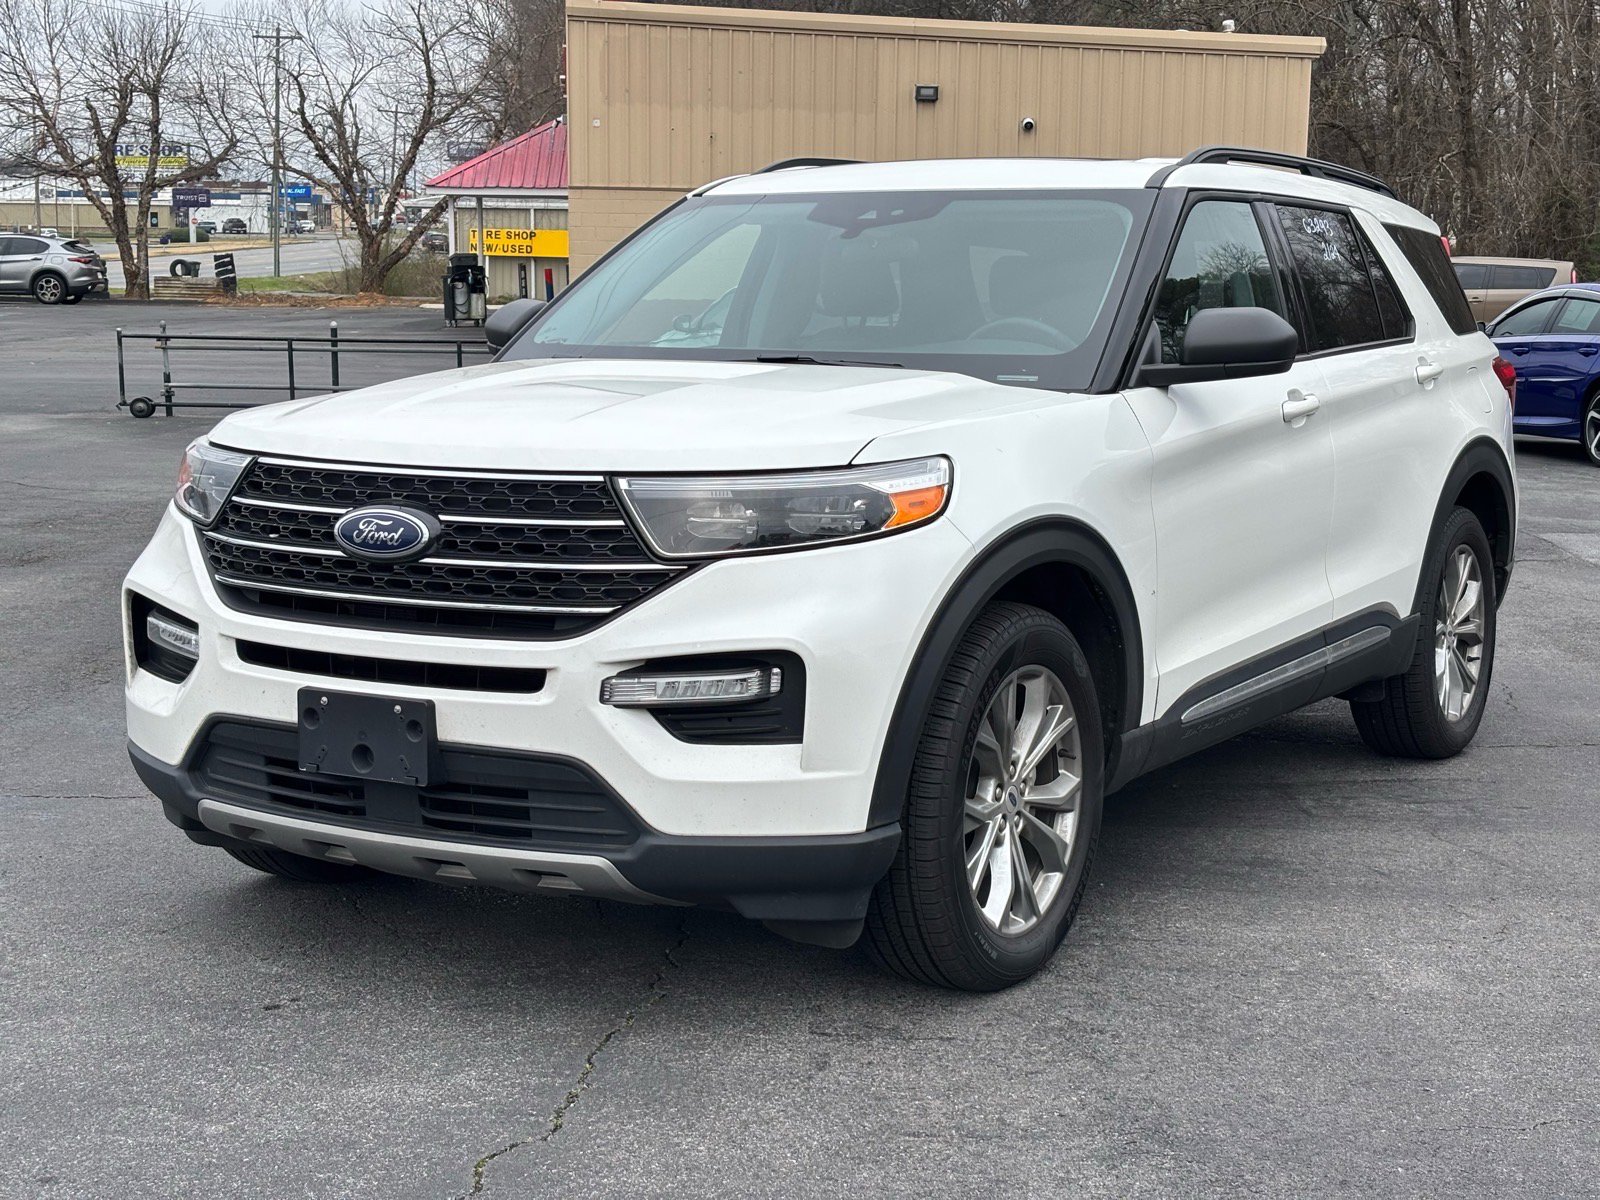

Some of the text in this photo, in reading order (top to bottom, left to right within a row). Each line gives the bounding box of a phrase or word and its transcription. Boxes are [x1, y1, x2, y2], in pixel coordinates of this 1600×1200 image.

[139, 144, 183, 157] SOP
[470, 230, 537, 241] TRE SHOP
[353, 518, 405, 546] Ford
